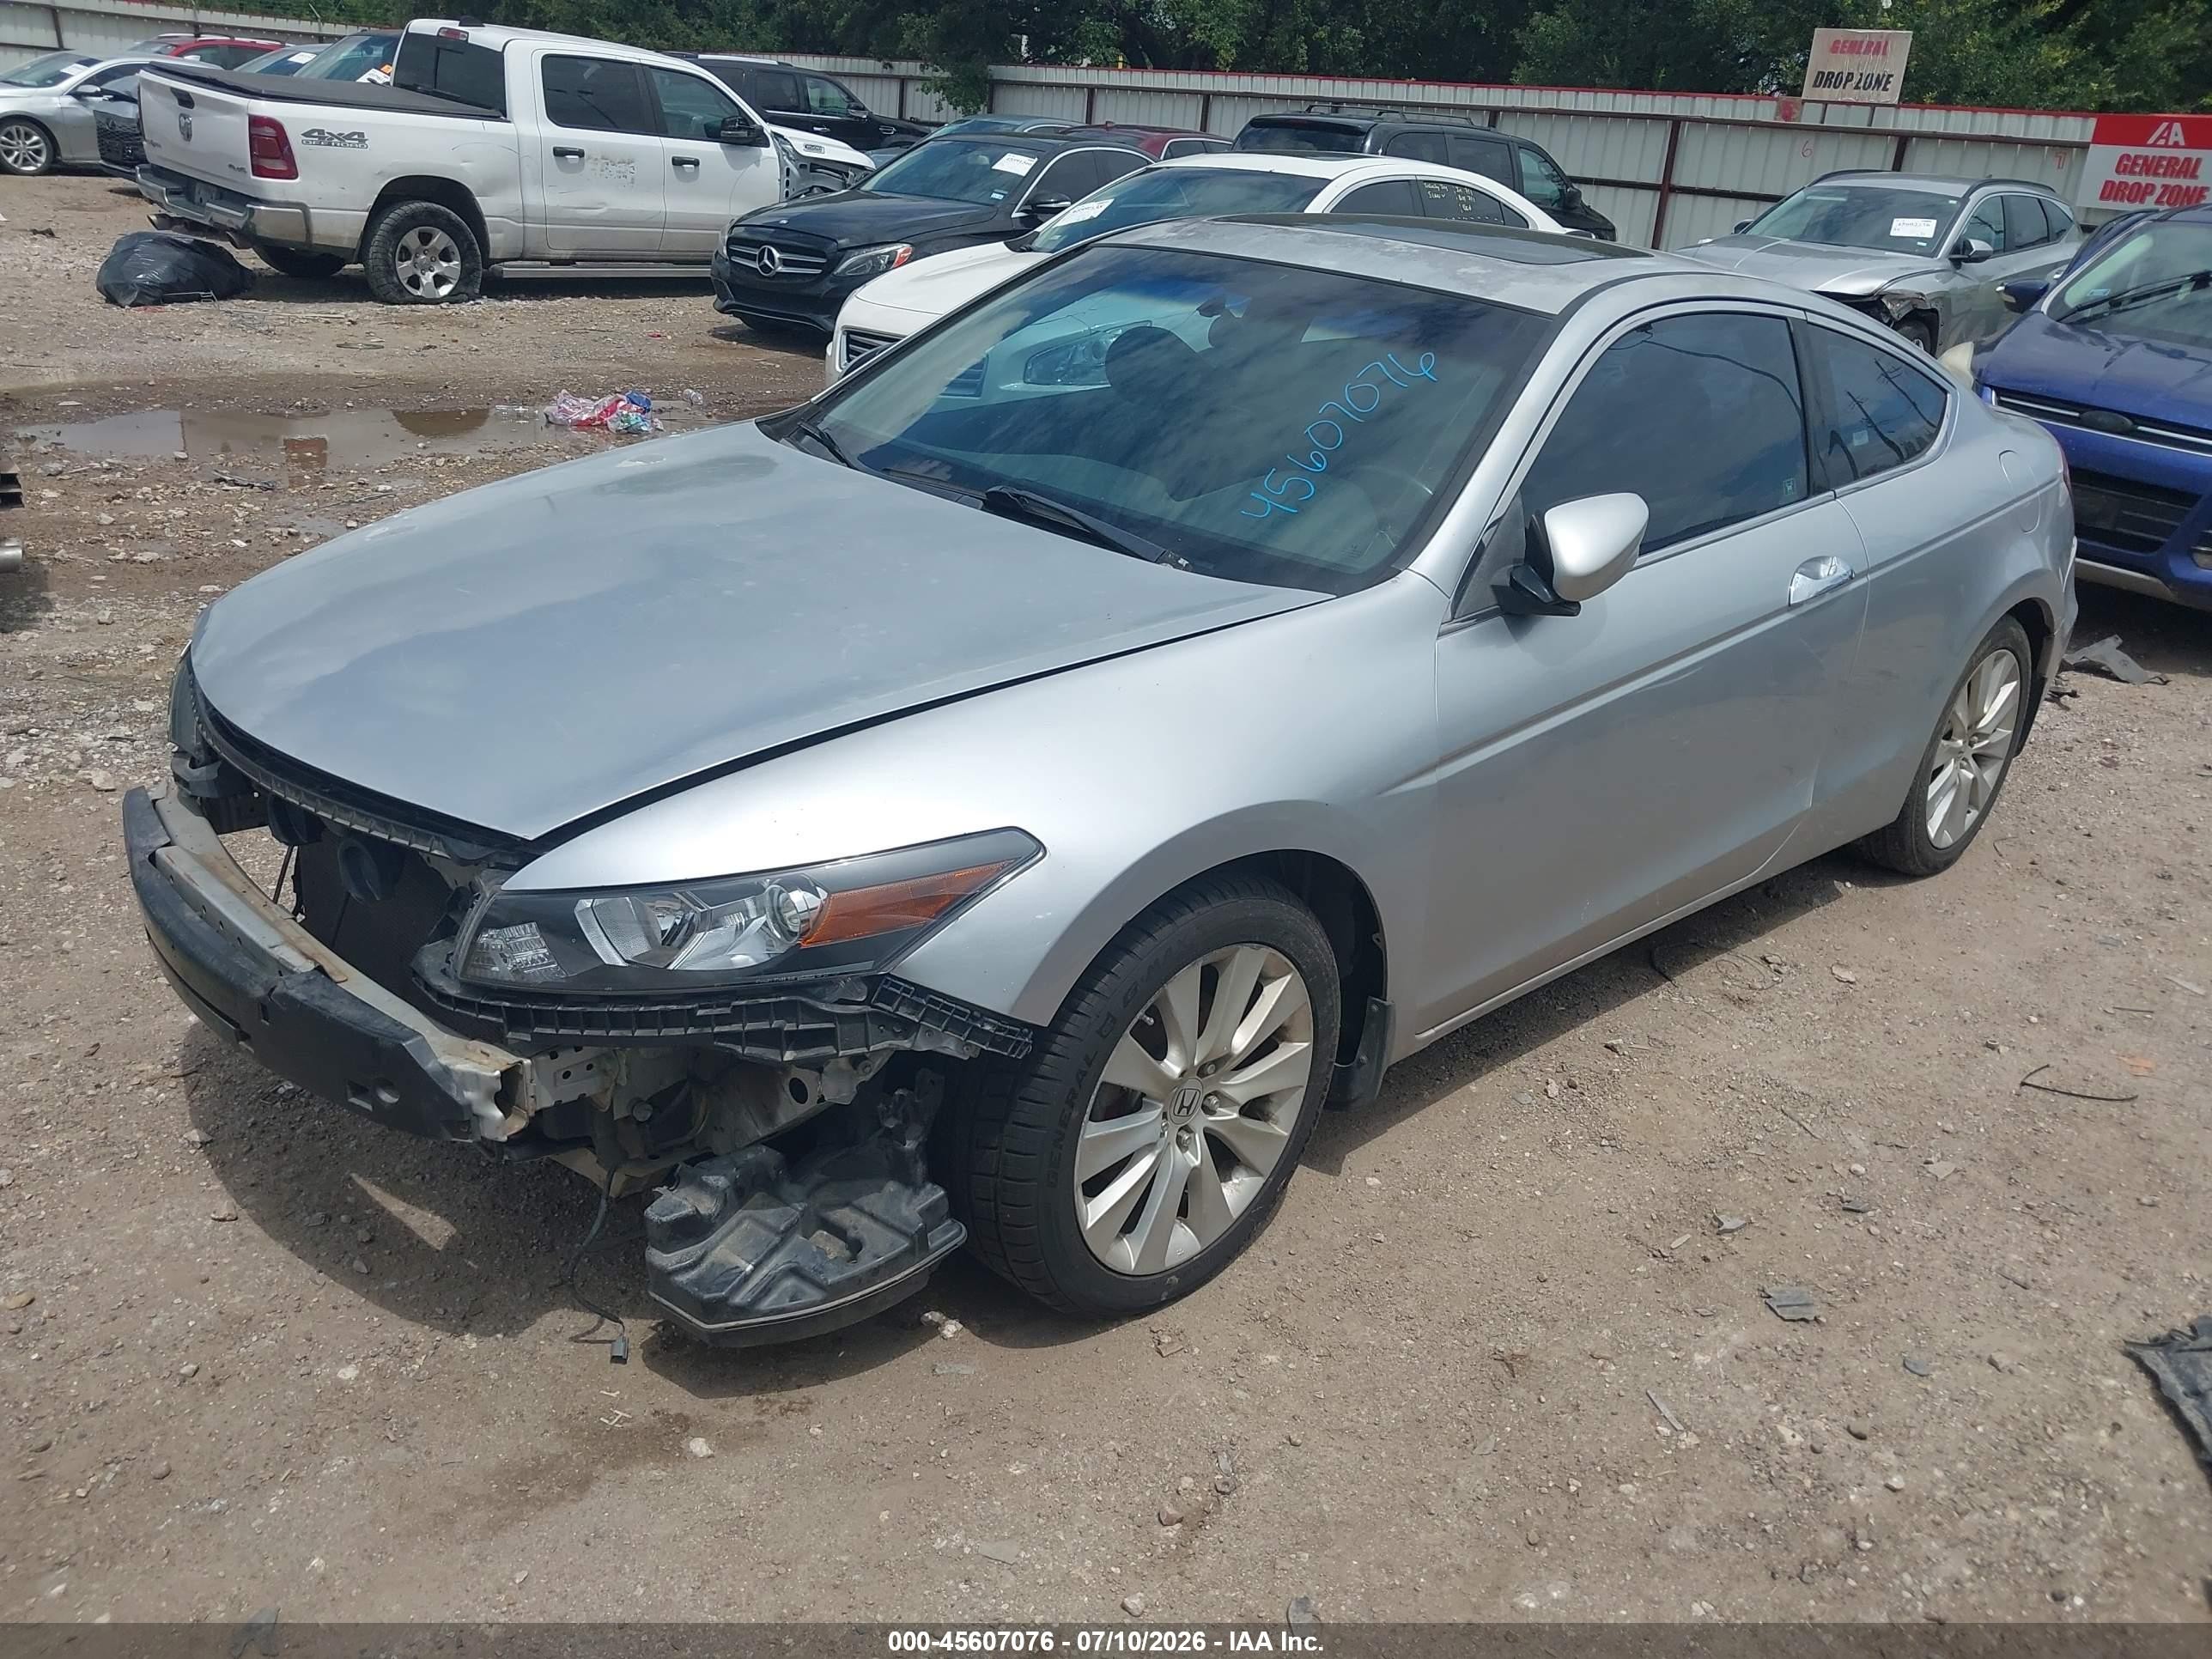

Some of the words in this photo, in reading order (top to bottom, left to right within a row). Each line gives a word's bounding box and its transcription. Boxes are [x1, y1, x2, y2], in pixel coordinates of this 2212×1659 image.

[1812, 70, 1855, 90] DROP
[1853, 71, 1894, 91] ZONE
[2115, 153, 2203, 179] GENERAL
[2099, 179, 2156, 204] DROP
[2154, 183, 2210, 208] ZONE
[1241, 351, 1439, 519] 45607076
[1043, 1049, 1099, 1188] GENERAL
